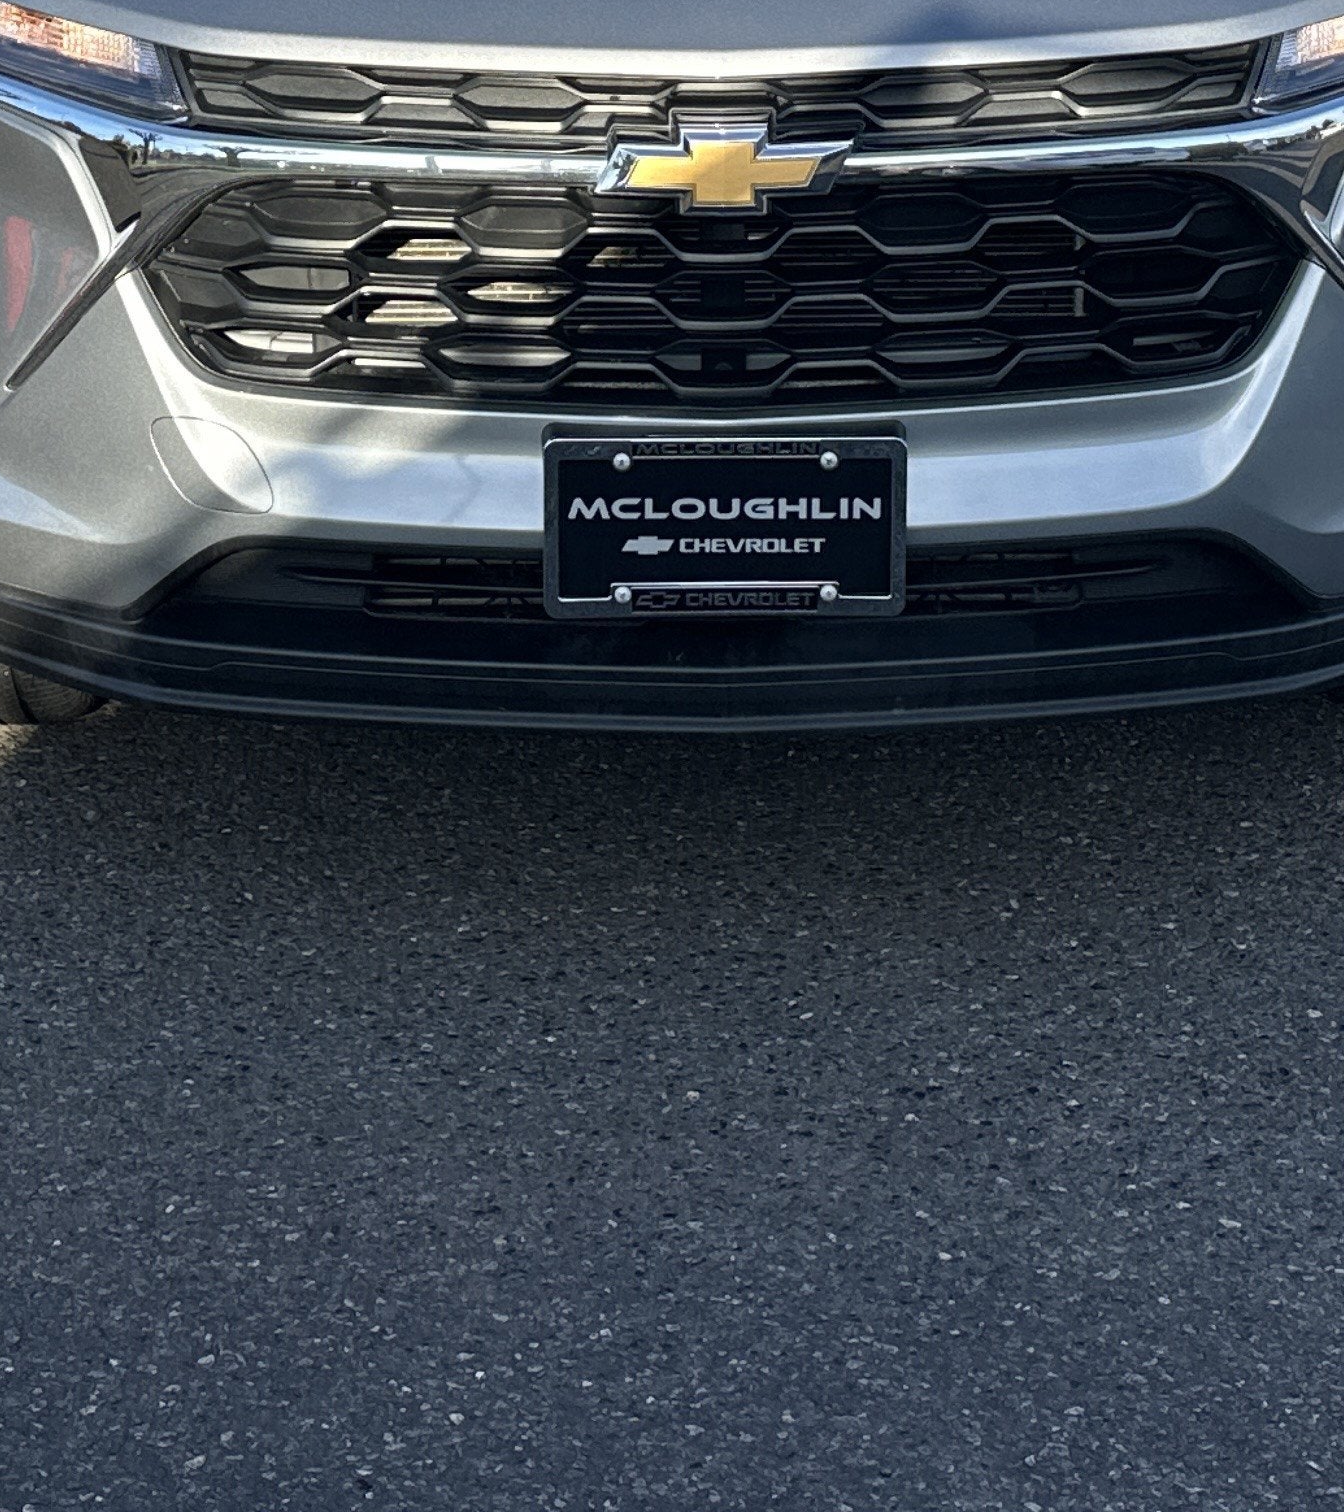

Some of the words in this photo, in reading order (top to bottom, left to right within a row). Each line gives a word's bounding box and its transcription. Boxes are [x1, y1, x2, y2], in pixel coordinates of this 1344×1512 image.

[568, 497, 881, 520] MCLOUGHLIN
[679, 537, 826, 553] CHEVROLET
[685, 591, 814, 606] CHEVROLET
